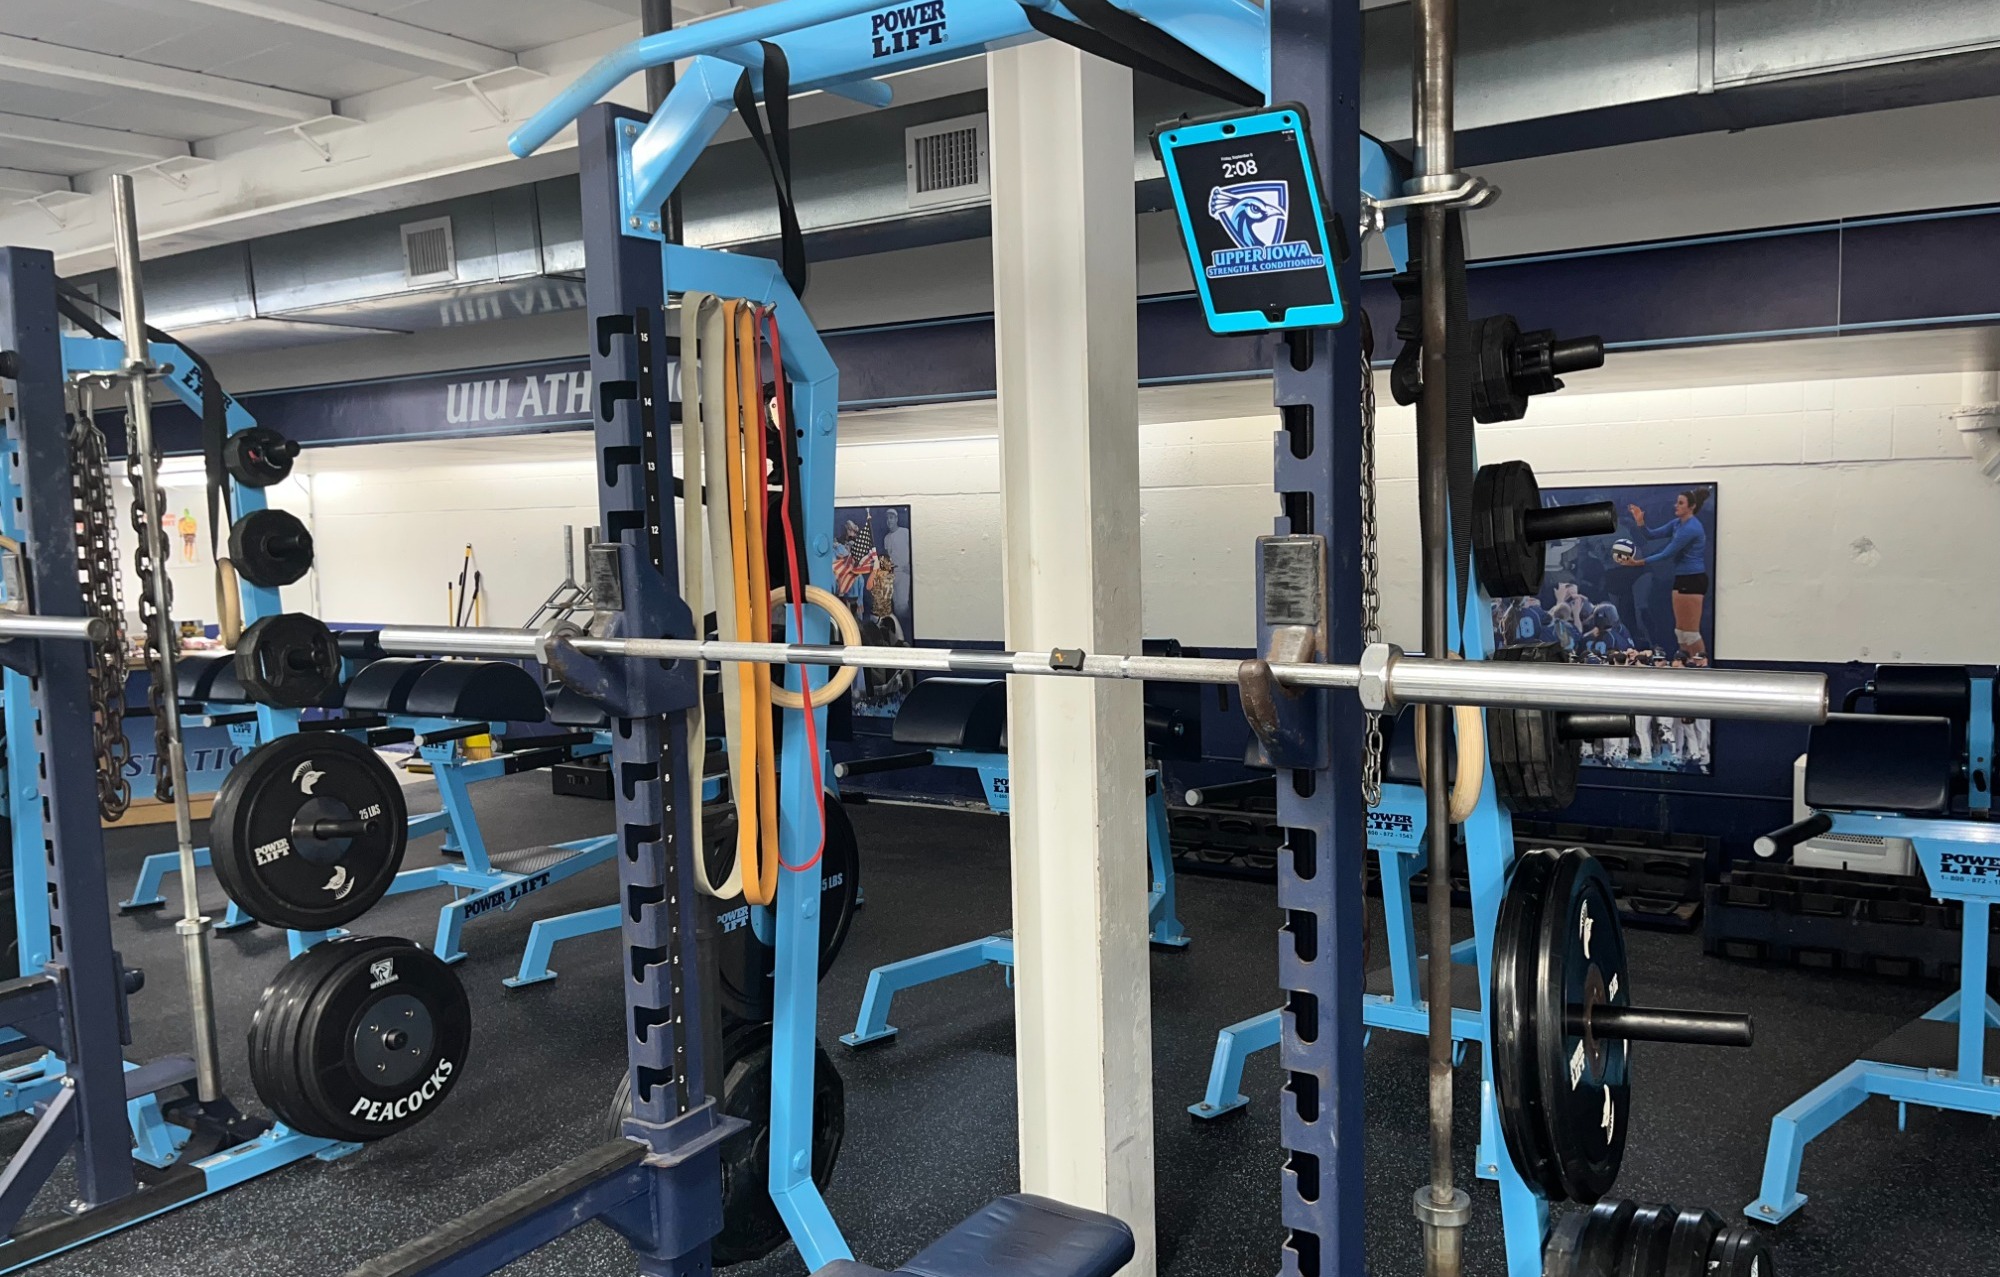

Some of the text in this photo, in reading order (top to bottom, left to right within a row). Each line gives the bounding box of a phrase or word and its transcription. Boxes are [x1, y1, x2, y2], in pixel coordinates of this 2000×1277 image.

[871, 0, 946, 36] POWER
[872, 21, 946, 59] LIFT
[1222, 160, 1258, 178] 2:08
[1214, 244, 1310, 266] UPPER IOWA
[1208, 257, 1323, 276] STRENGTH & CONDITIONING
[641, 333, 649, 342] 15
[643, 366, 649, 374] N
[446, 378, 509, 424] UIU
[644, 398, 652, 407] 14
[647, 462, 655, 471] 13
[651, 526, 659, 534] 12
[358, 804, 381, 820] 25 LBS
[254, 838, 289, 857] POWER
[256, 846, 290, 866] LIFT
[828, 873, 843, 889] LBS
[464, 872, 550, 919] POWER LIFT
[350, 1058, 453, 1122] PEACOCKS
